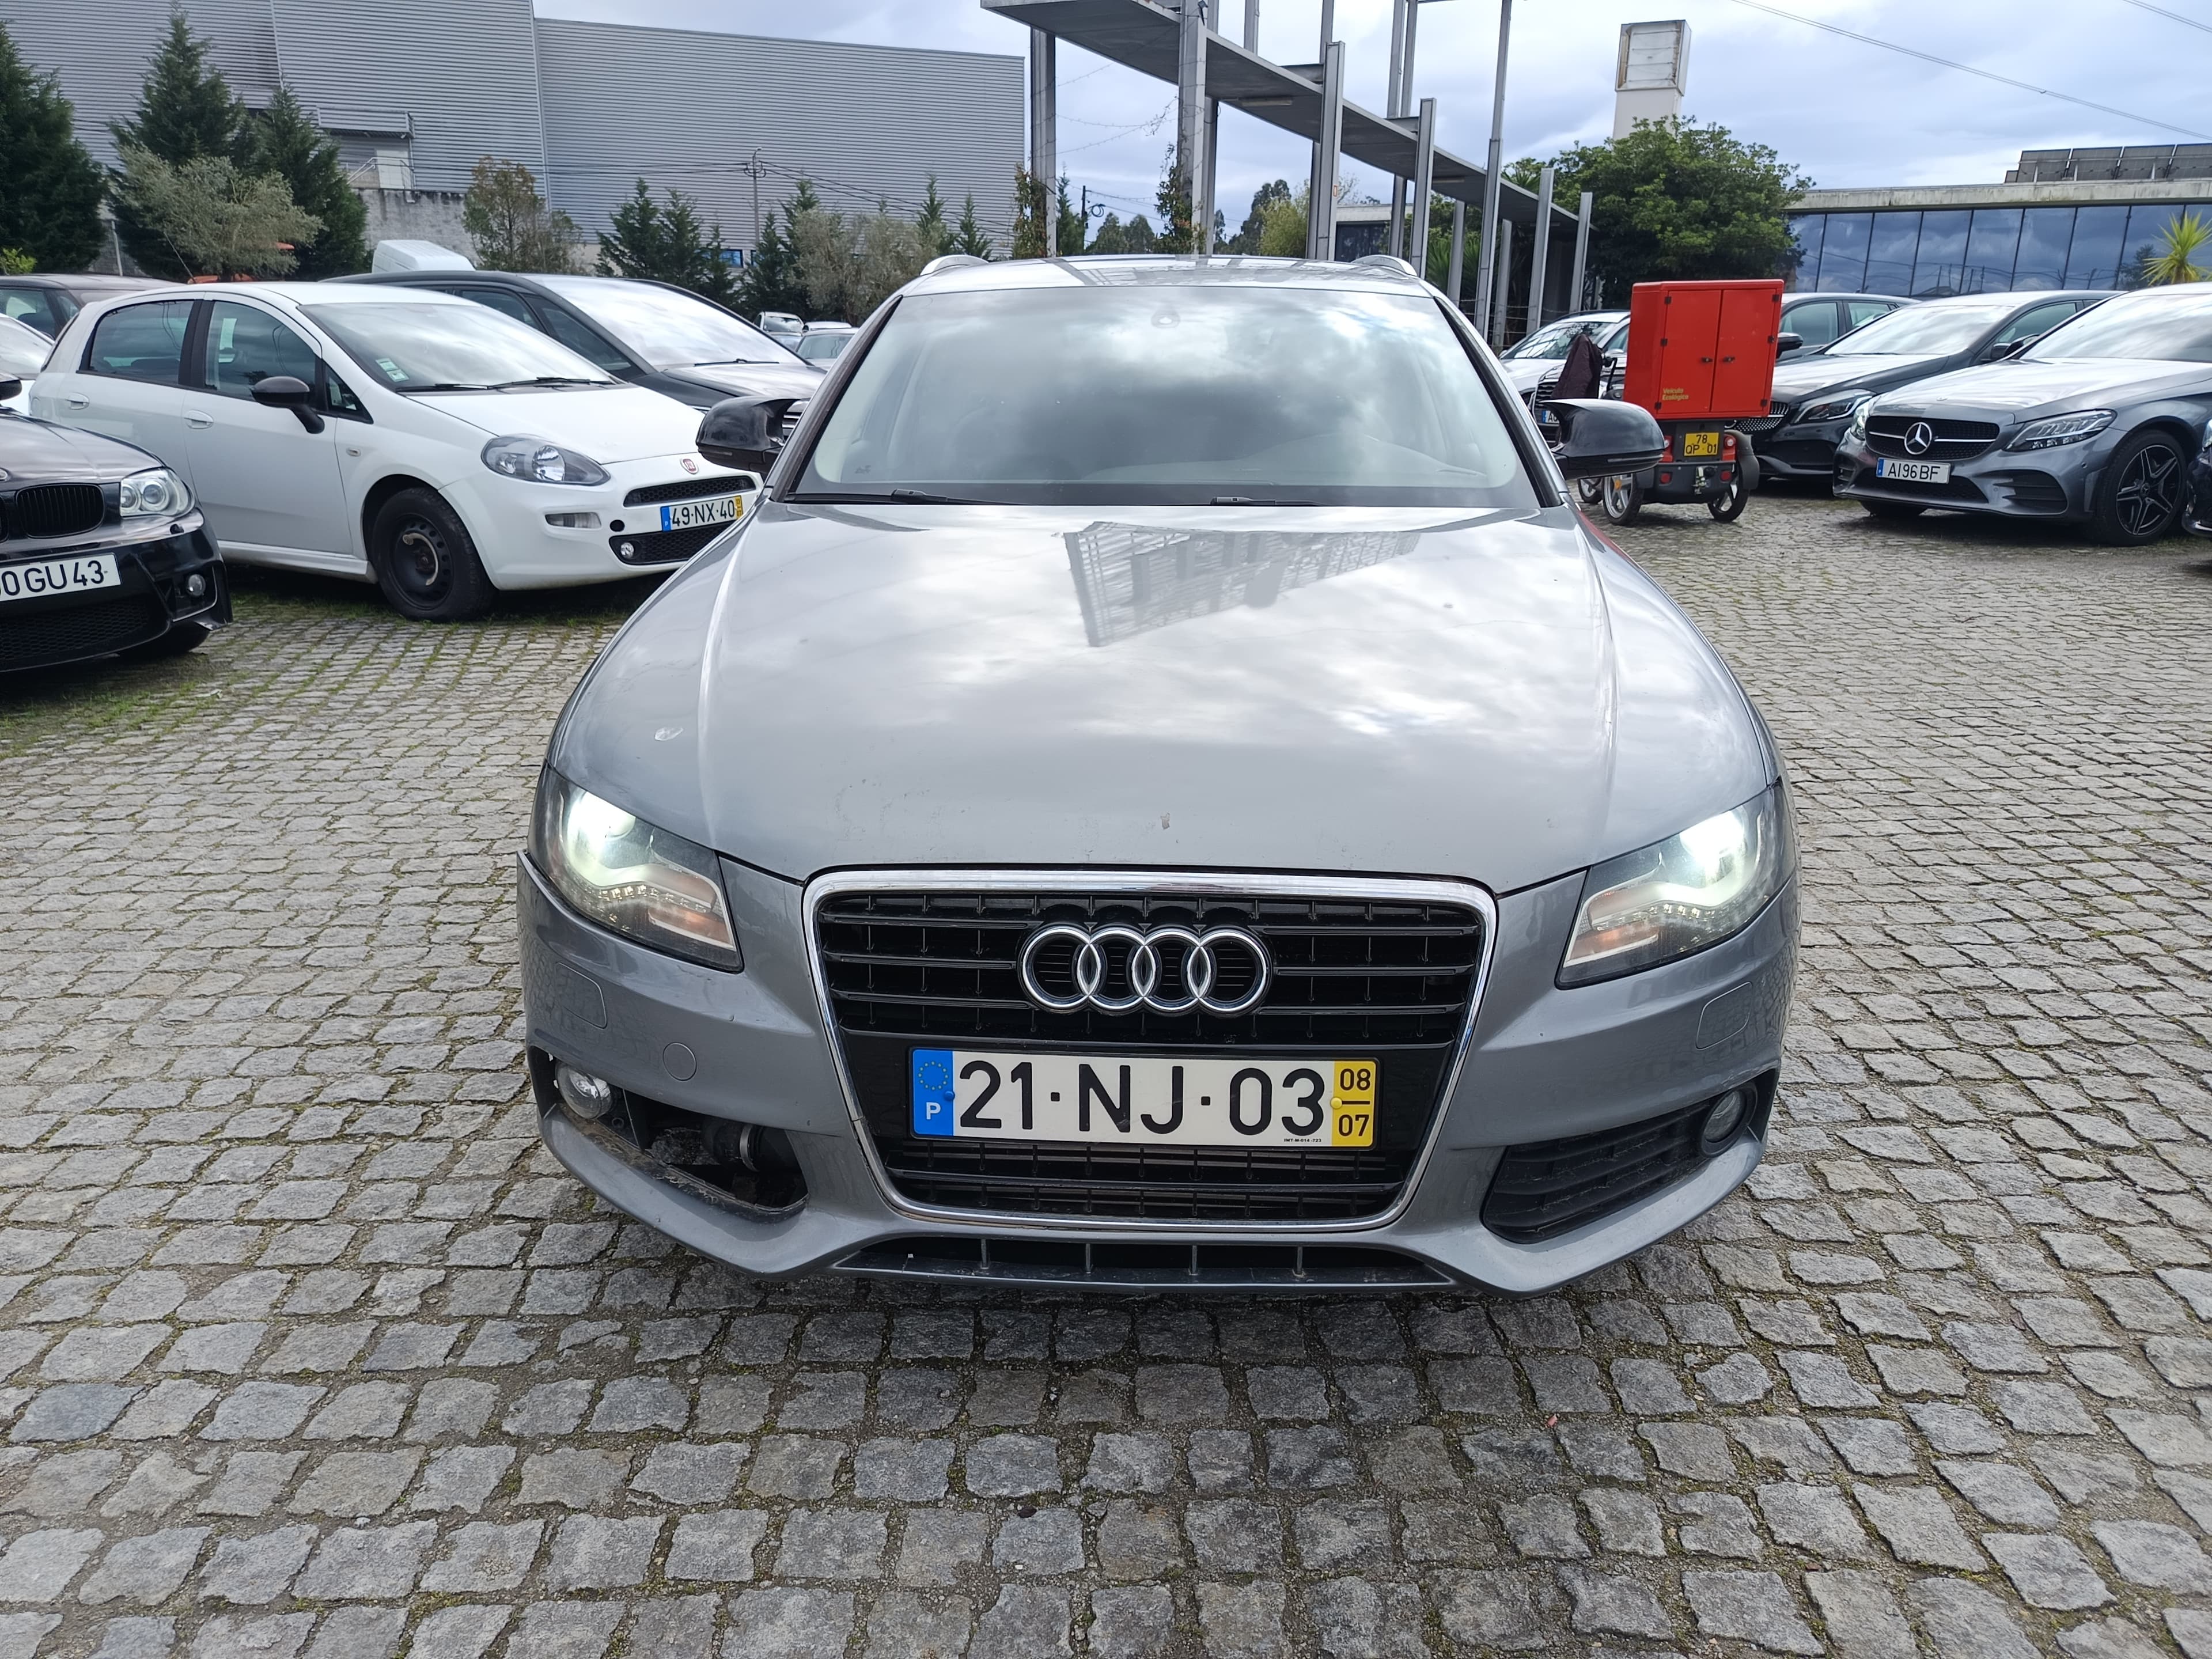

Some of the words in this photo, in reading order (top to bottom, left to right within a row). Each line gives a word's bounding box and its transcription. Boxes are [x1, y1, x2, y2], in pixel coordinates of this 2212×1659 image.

[1696, 434, 1707, 444] 78
[0, 560, 104, 596] 0GU43
[1340, 1069, 1370, 1090] 08
[926, 1102, 941, 1120] P
[1339, 1114, 1369, 1137] 07
